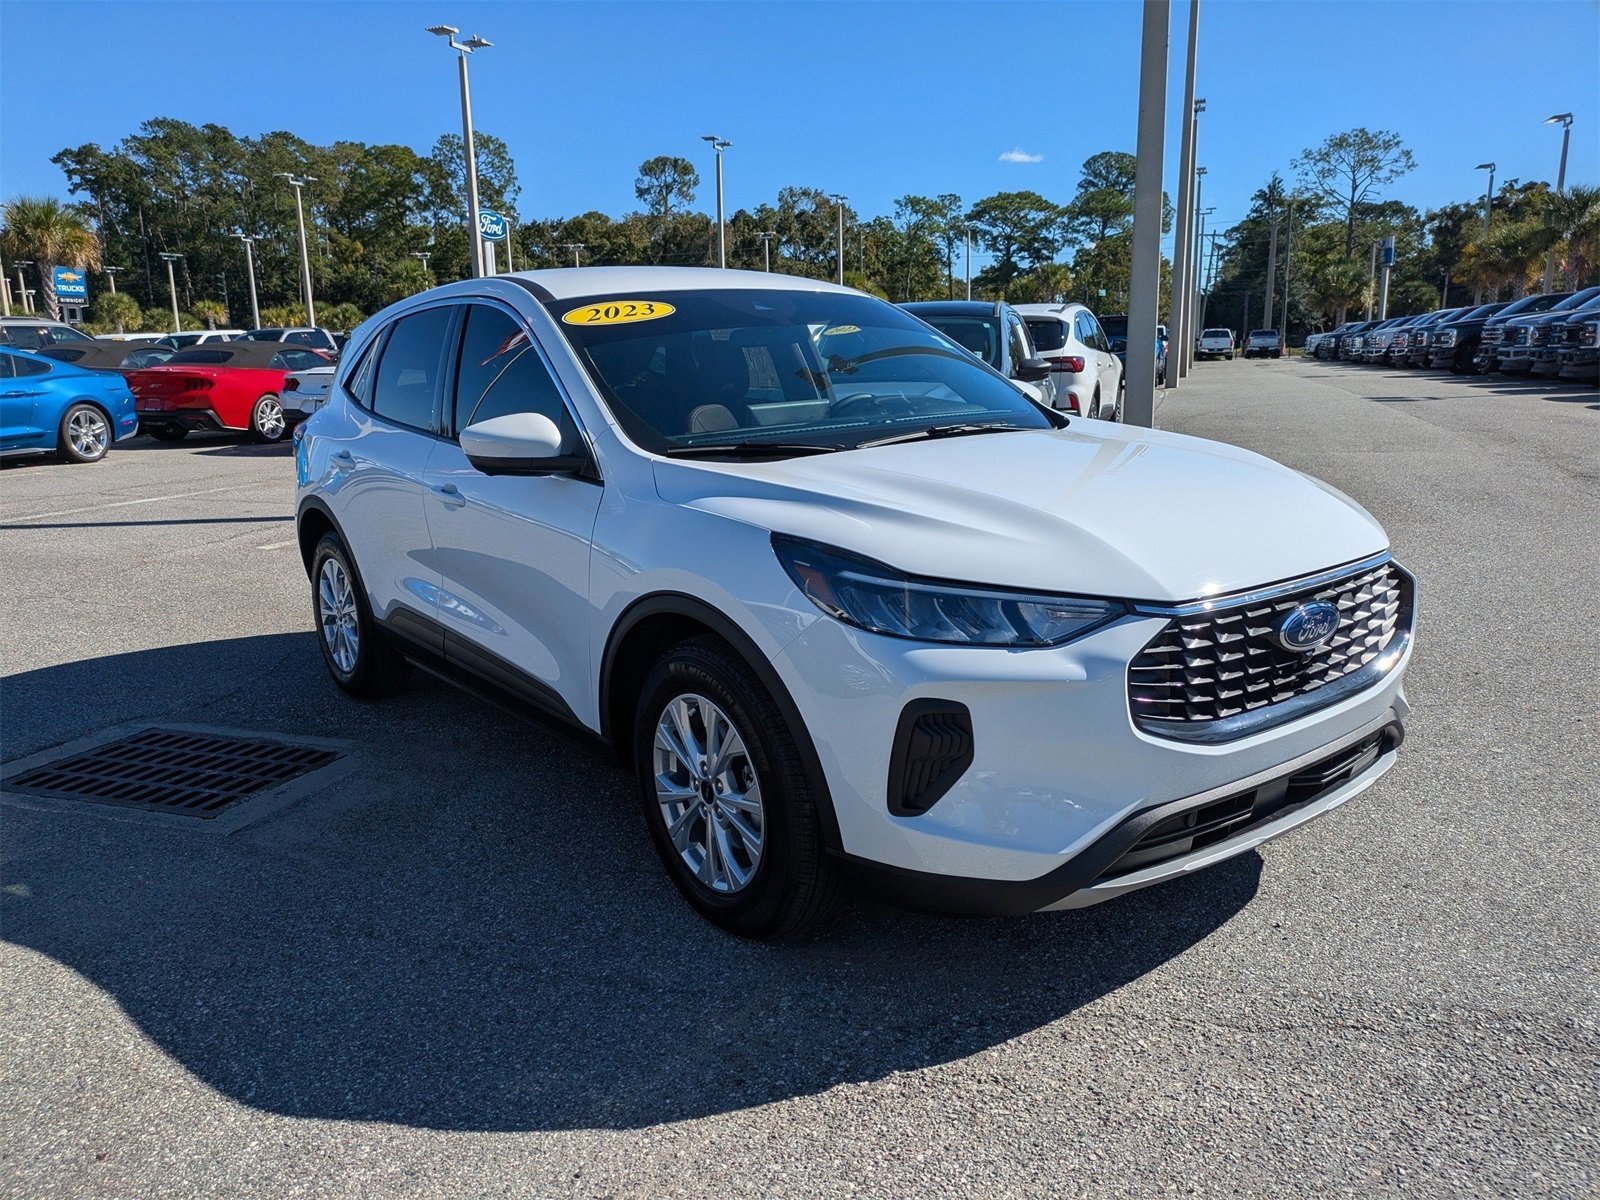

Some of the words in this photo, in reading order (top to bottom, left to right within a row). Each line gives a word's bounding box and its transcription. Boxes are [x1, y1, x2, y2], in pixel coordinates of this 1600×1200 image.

[480, 214, 503, 235] Ford
[57, 284, 85, 292] TRUCKS
[586, 303, 655, 323] 2023
[1298, 613, 1331, 642] Ford
